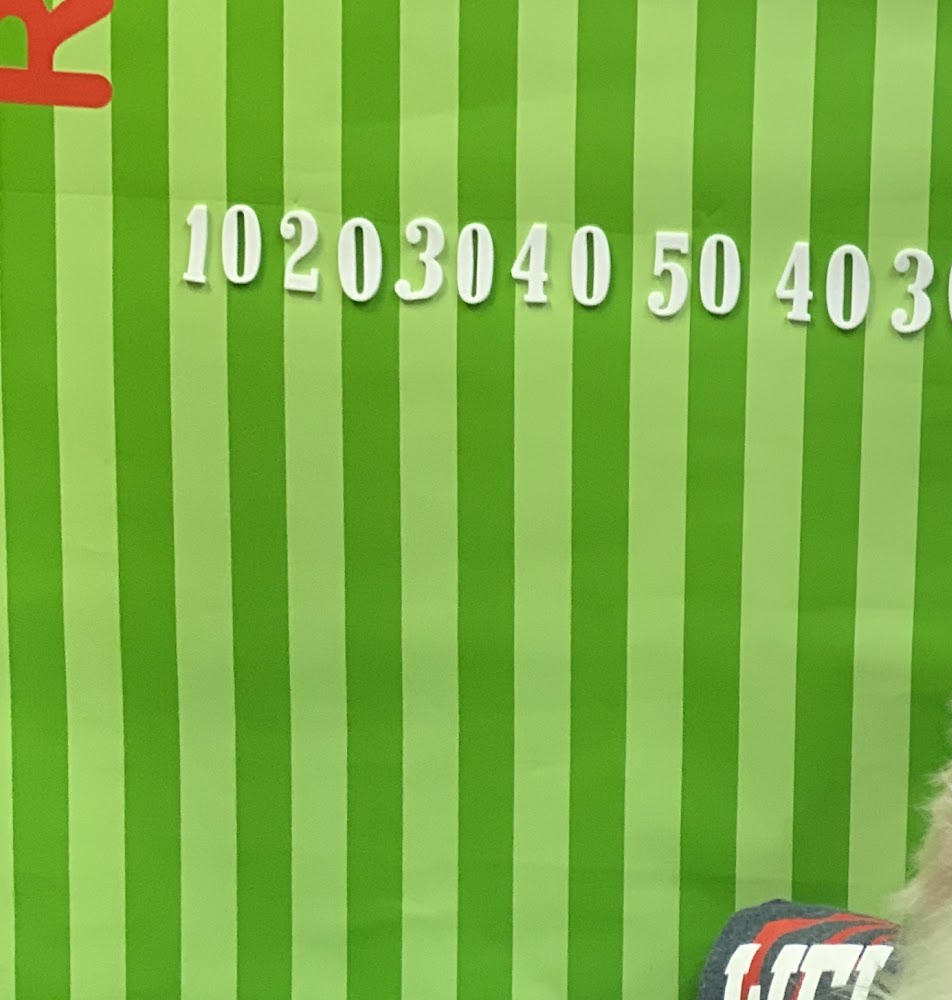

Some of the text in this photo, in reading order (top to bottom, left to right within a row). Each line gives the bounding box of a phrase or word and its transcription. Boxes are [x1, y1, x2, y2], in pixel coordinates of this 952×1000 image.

[182, 203, 262, 284] 10
[280, 209, 383, 302] 20
[394, 216, 495, 305] 30
[510, 222, 611, 306] 40
[647, 230, 742, 317] 50
[775, 241, 871, 330] 40
